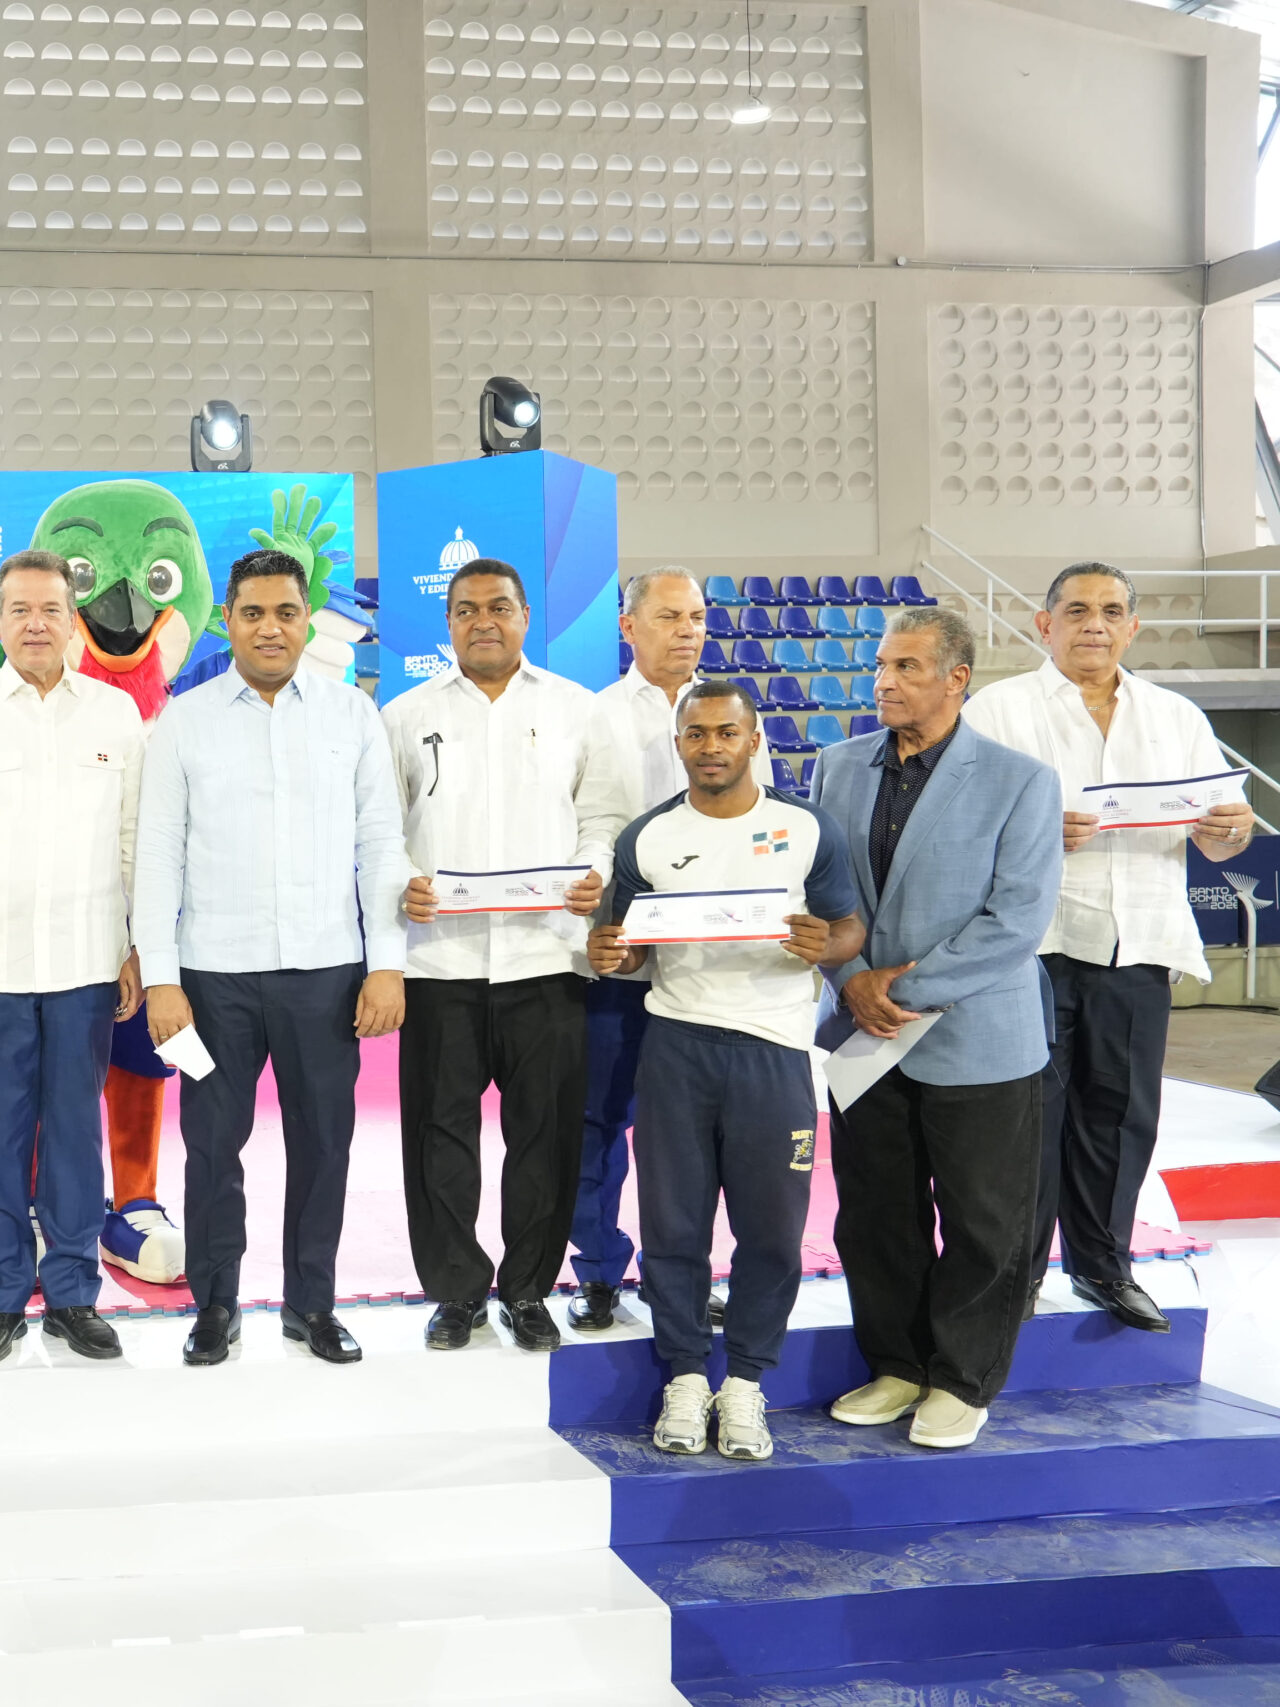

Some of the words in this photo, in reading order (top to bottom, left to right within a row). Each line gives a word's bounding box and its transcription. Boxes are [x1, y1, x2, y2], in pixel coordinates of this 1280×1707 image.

[412, 572, 455, 585] VIVIEND
[1189, 887, 1230, 895] SANTO
[1190, 894, 1238, 903] DOMINGO
